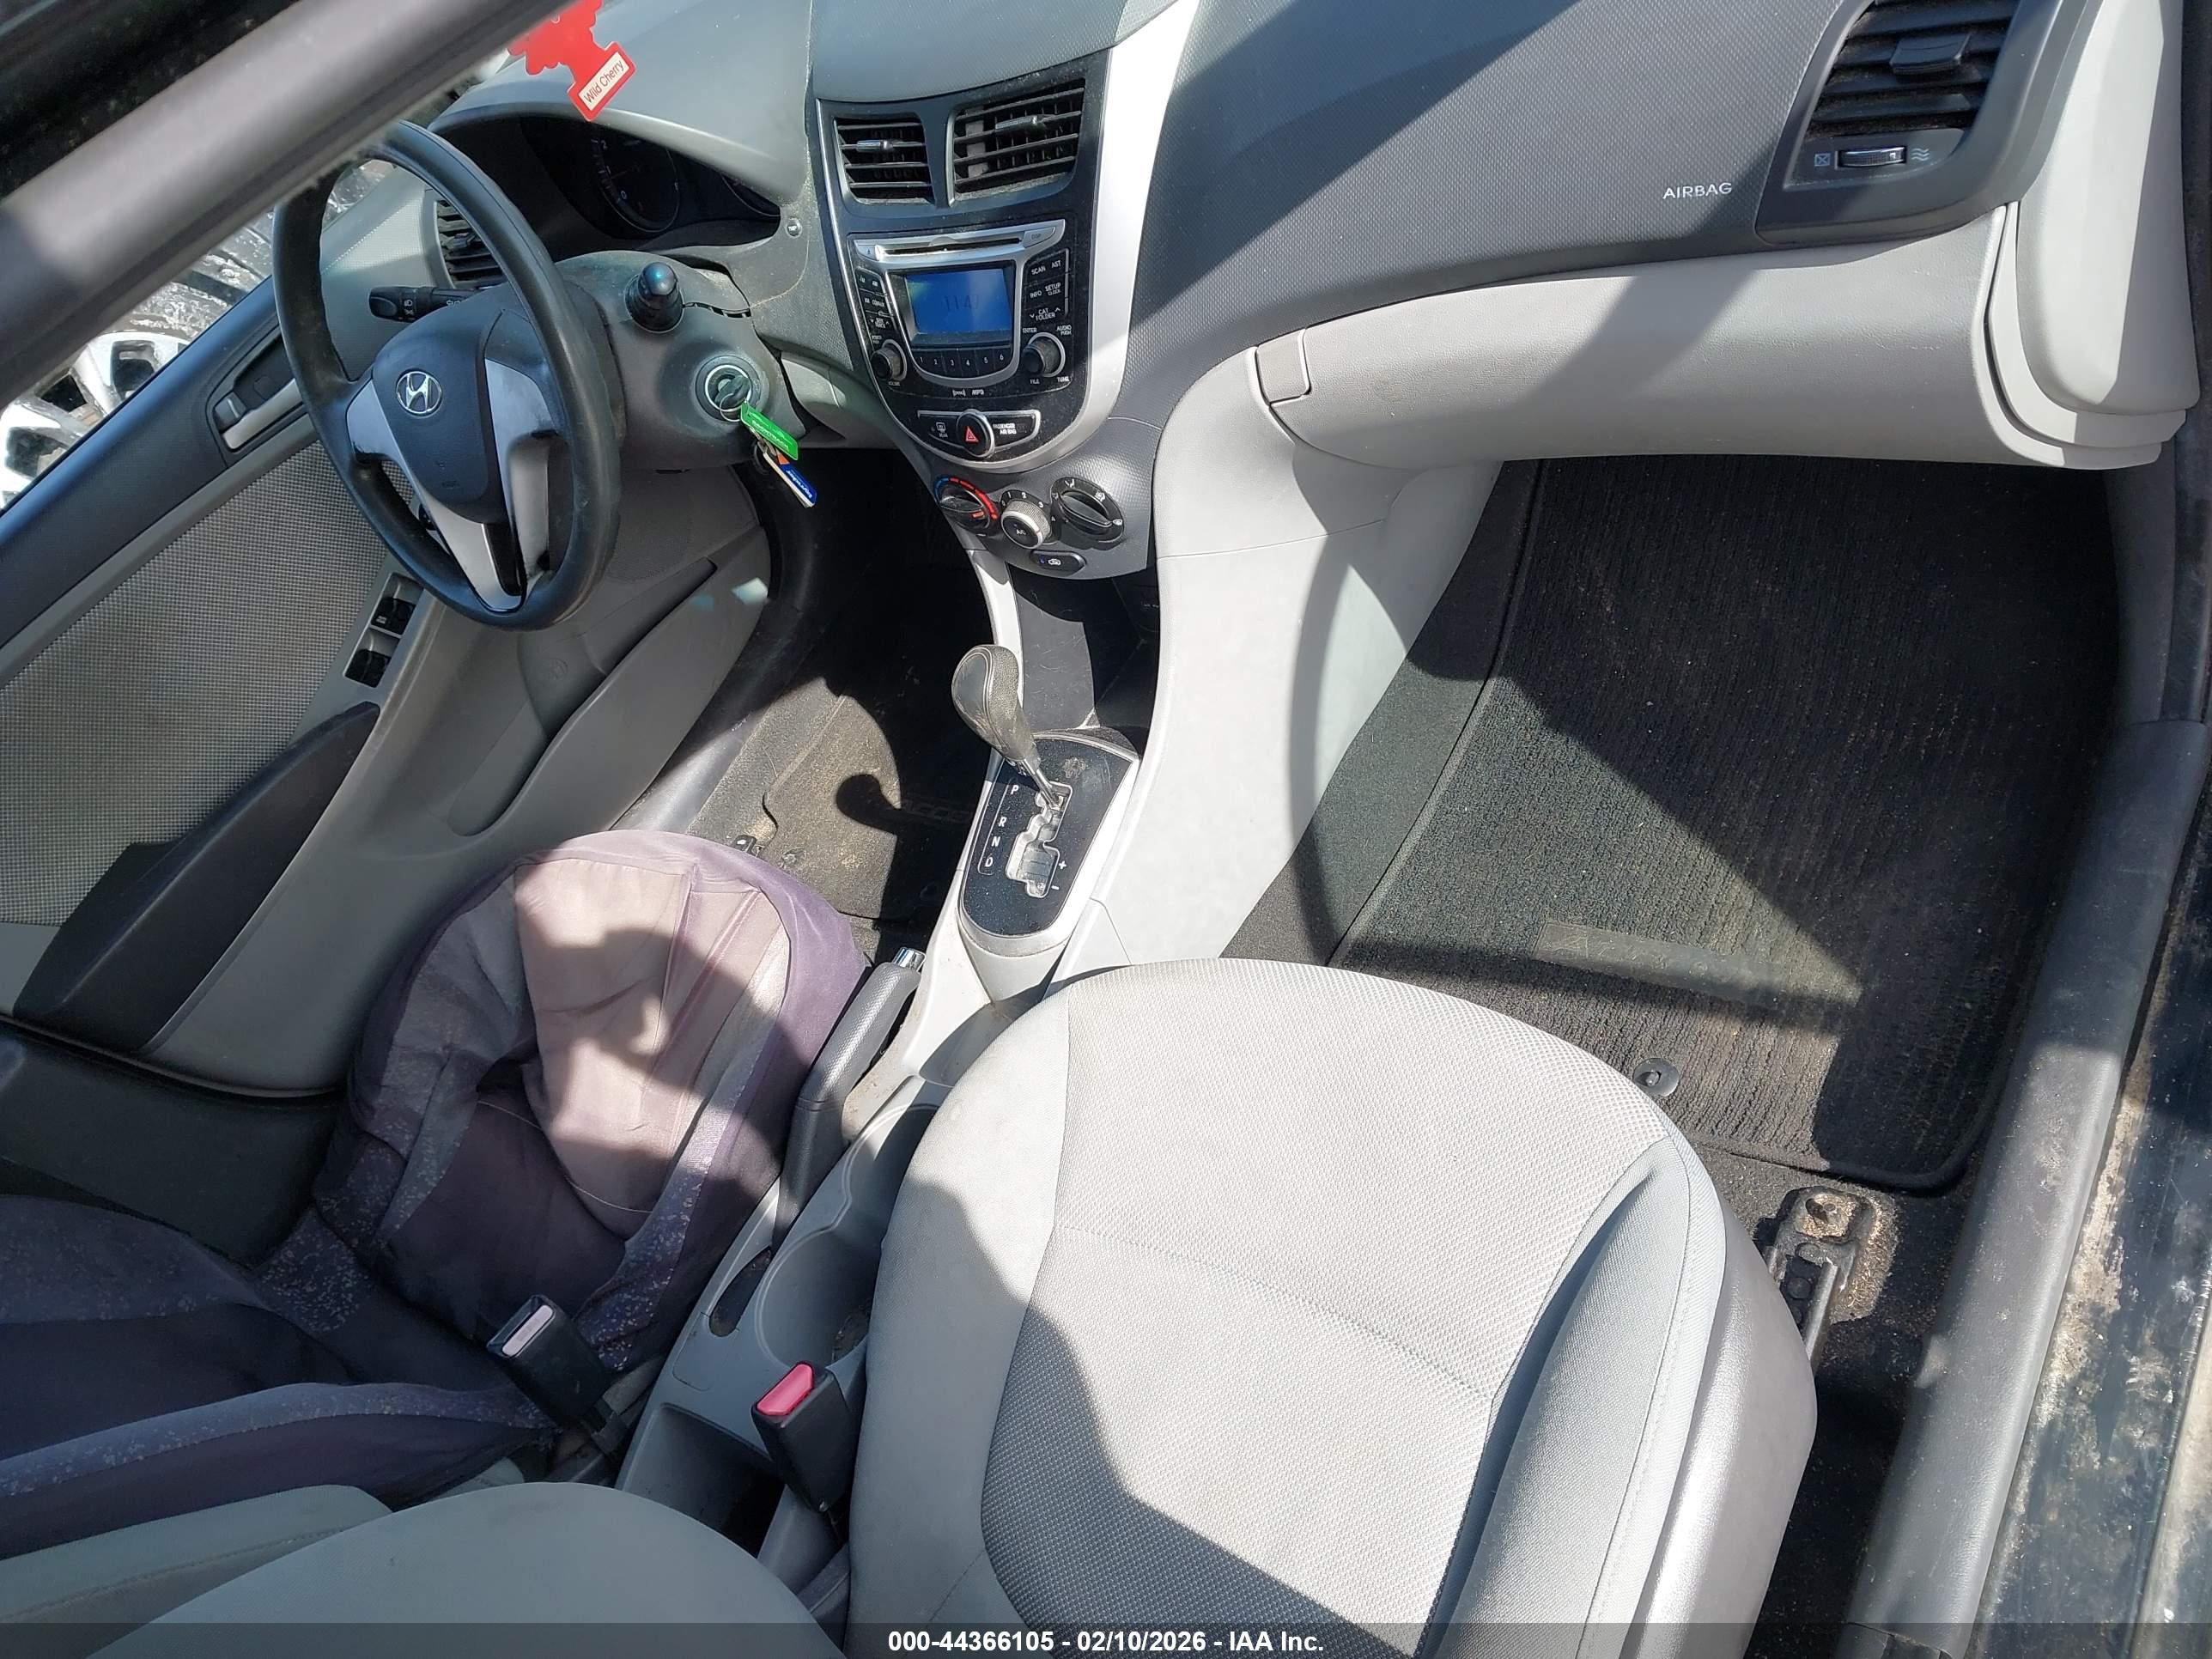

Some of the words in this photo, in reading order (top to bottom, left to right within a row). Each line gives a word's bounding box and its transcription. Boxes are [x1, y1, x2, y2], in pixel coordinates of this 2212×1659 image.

[583, 82, 603, 103] Wild
[599, 60, 624, 87] Cherry
[1662, 182, 1733, 200] AIRBAG
[1051, 259, 1062, 269] AST
[1031, 265, 1047, 276] SCAN
[1044, 282, 1061, 292] SETUP
[1030, 290, 1042, 299] INFO
[1036, 312, 1056, 322] FOLDER
[1010, 784, 1020, 795] P
[998, 816, 1008, 828] R
[991, 836, 1001, 848] N
[984, 856, 994, 867] D
